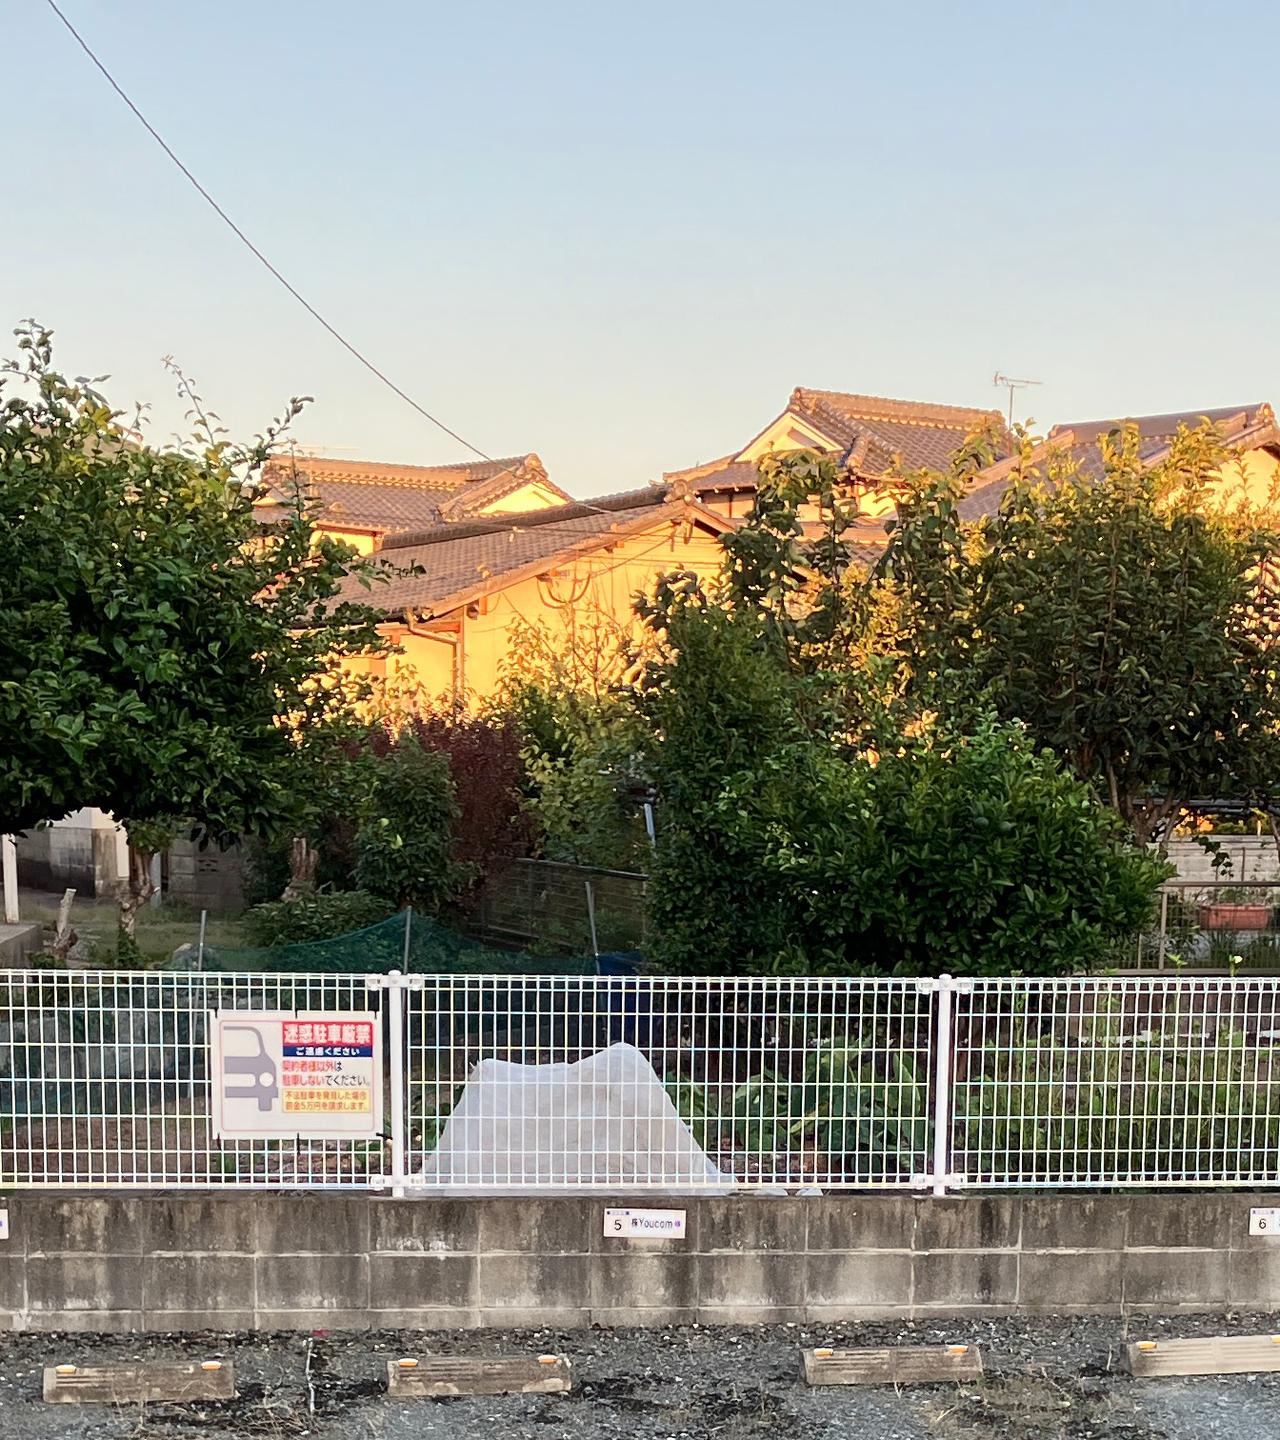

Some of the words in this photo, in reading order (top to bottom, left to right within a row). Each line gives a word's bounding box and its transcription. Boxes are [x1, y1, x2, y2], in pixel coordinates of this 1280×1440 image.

[284, 1024, 370, 1044] 迷惑駐車厳禁
[296, 1047, 360, 1056] ご遠慮ください
[283, 1061, 343, 1072] 契約者様以外は
[283, 1075, 370, 1086] 駐車しないでください。
[614, 1219, 623, 1231] 5
[1259, 1218, 1267, 1230] 6
